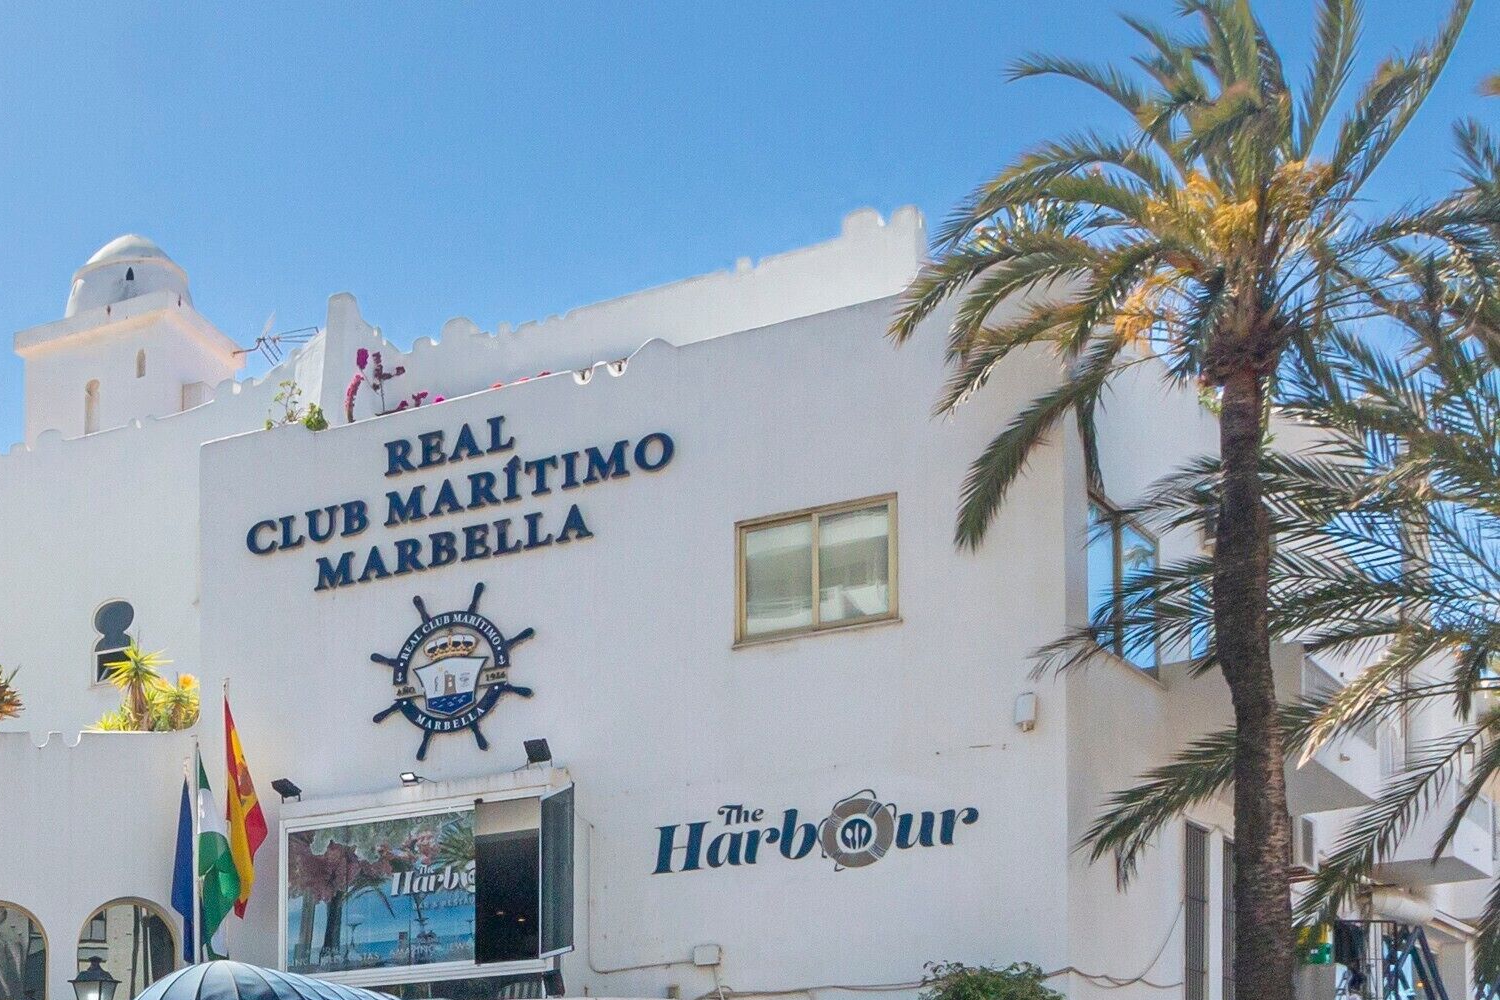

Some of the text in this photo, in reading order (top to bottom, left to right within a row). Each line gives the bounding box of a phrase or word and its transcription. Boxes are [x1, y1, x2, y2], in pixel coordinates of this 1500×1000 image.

[384, 415, 516, 478] REAL
[246, 432, 675, 555] CLUB MARÍTIMO
[314, 503, 594, 592] MARBELLA
[401, 634, 422, 661] REAL
[422, 615, 450, 634] CLUB
[415, 707, 485, 730] MARBELLA
[718, 804, 764, 826] The
